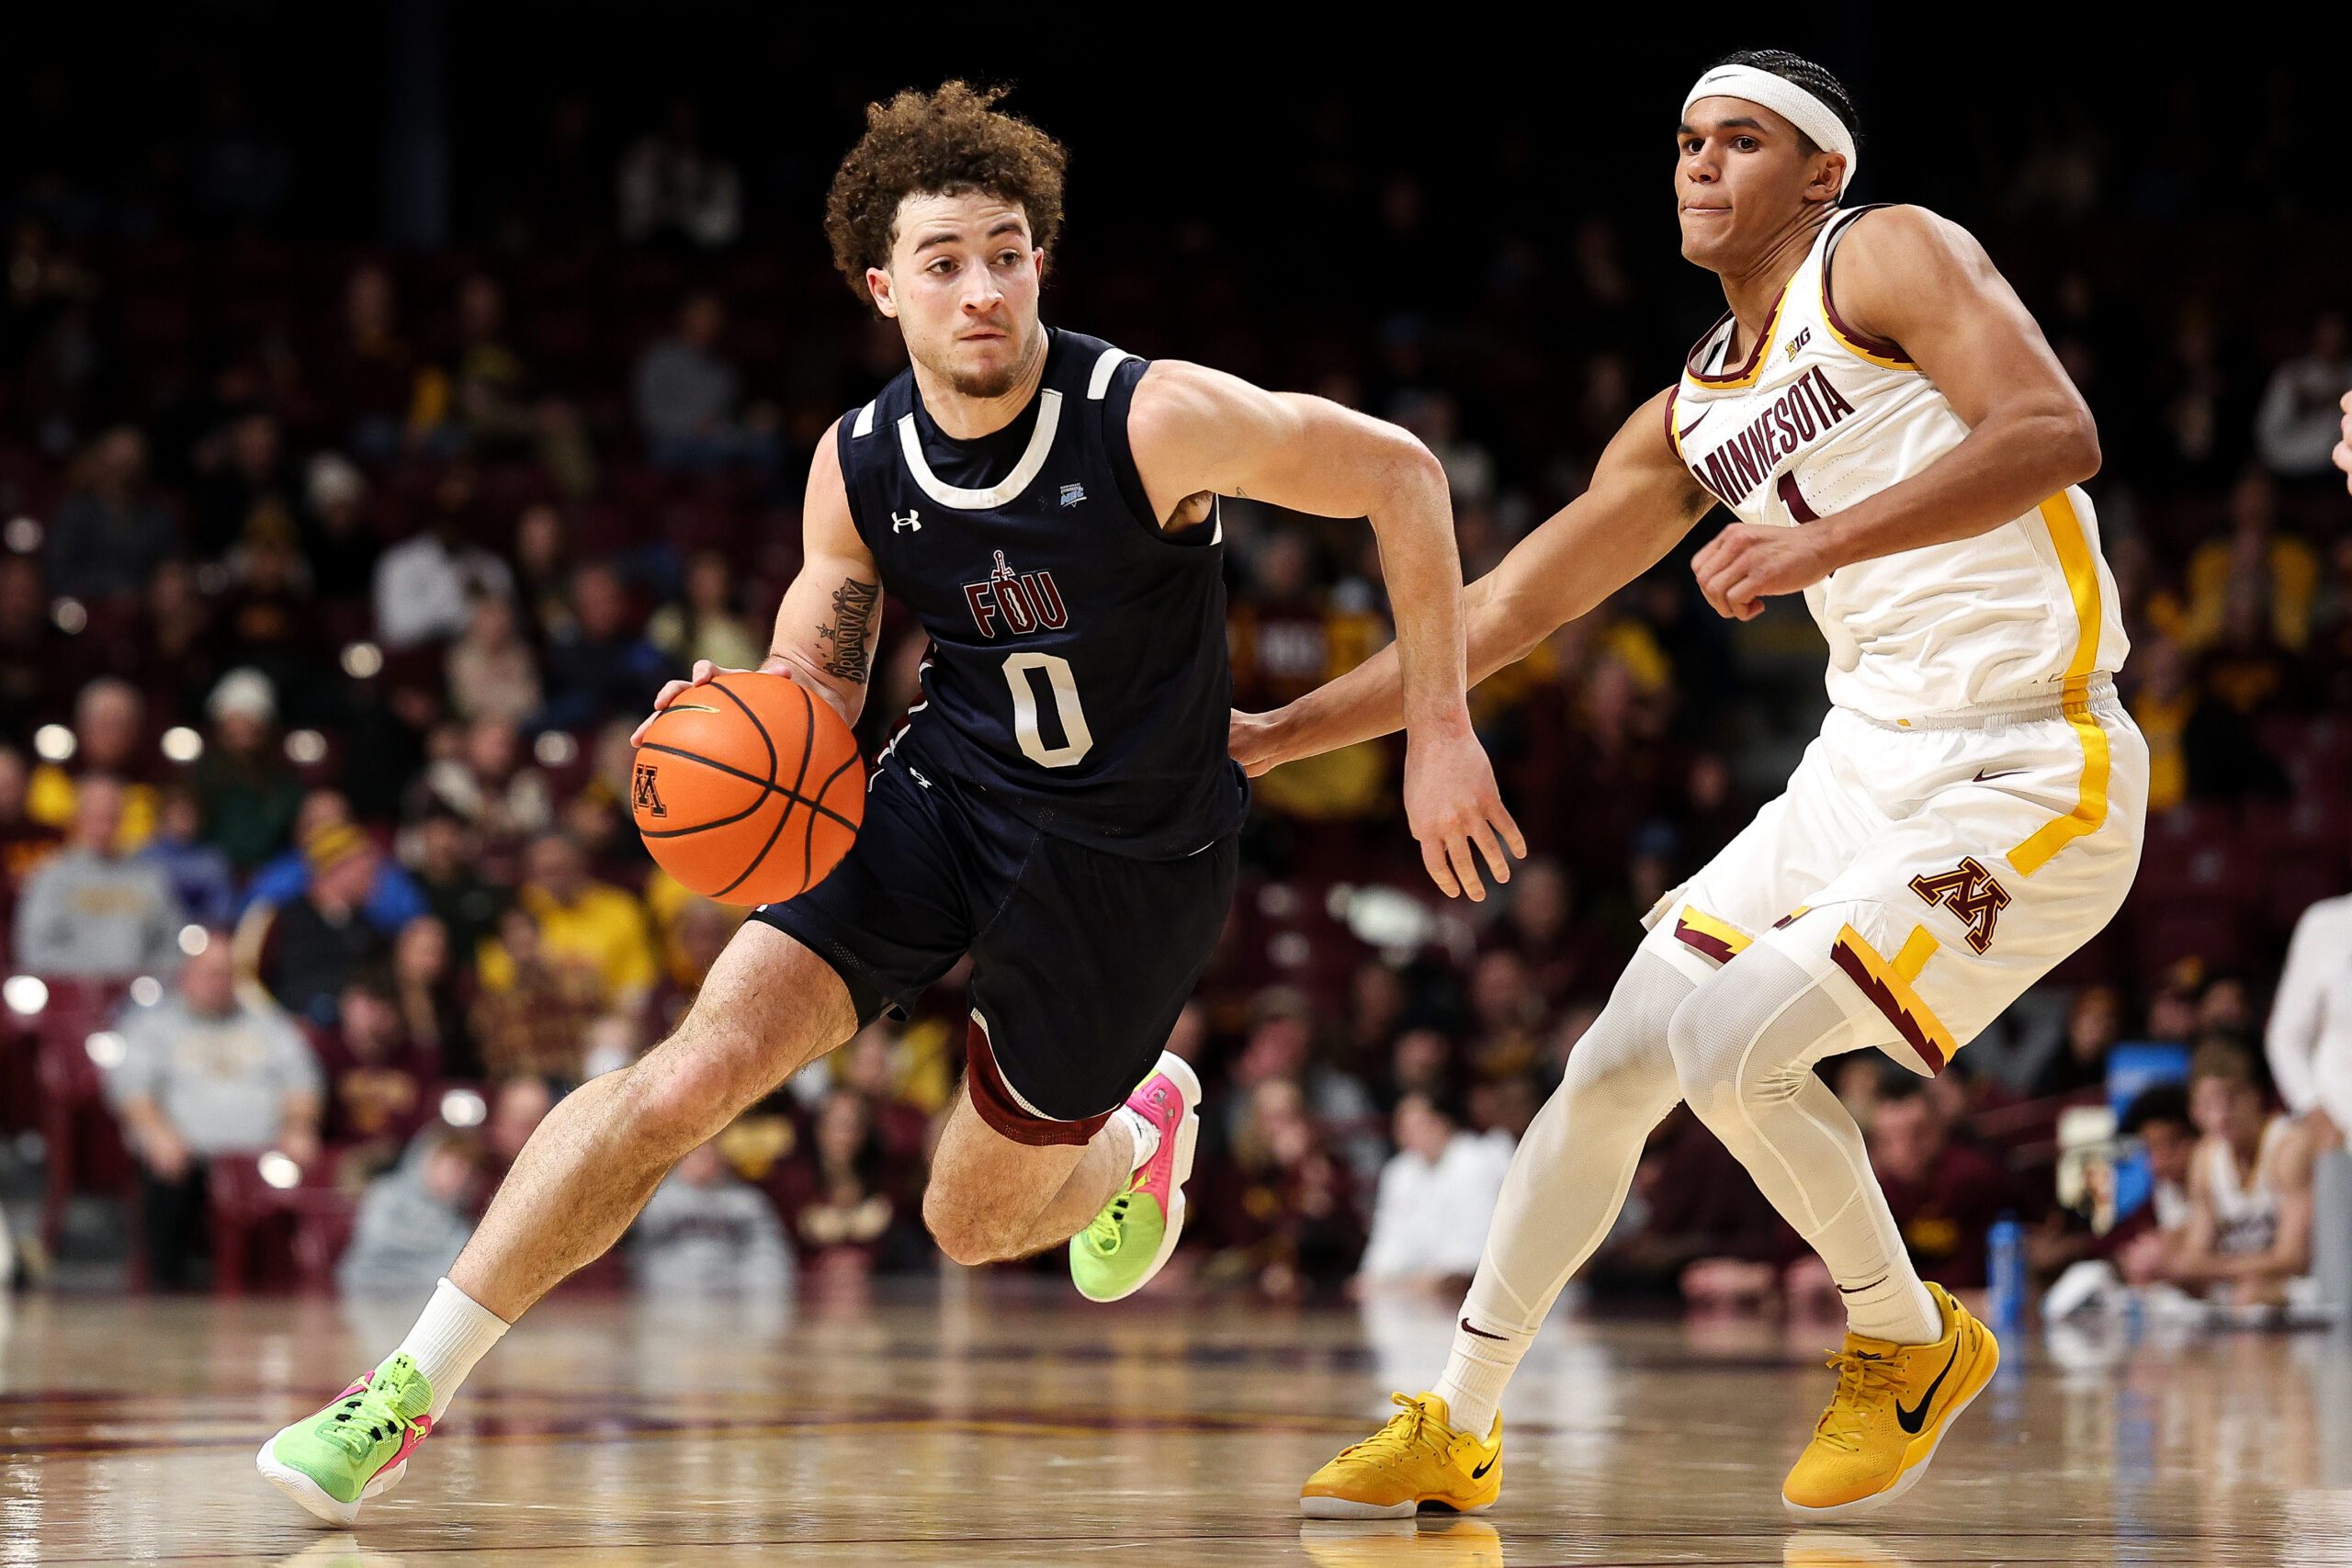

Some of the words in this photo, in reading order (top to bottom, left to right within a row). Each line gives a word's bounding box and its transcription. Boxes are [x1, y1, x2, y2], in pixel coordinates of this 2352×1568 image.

[1785, 326, 1811, 363] BIG
[1691, 365, 1856, 508] MINNESOTA
[831, 577, 878, 683] BROADWAY
[963, 570, 1069, 638] FDU
[1001, 652, 1093, 768] 0
[632, 764, 667, 818] M
[1907, 856, 2012, 955] M
